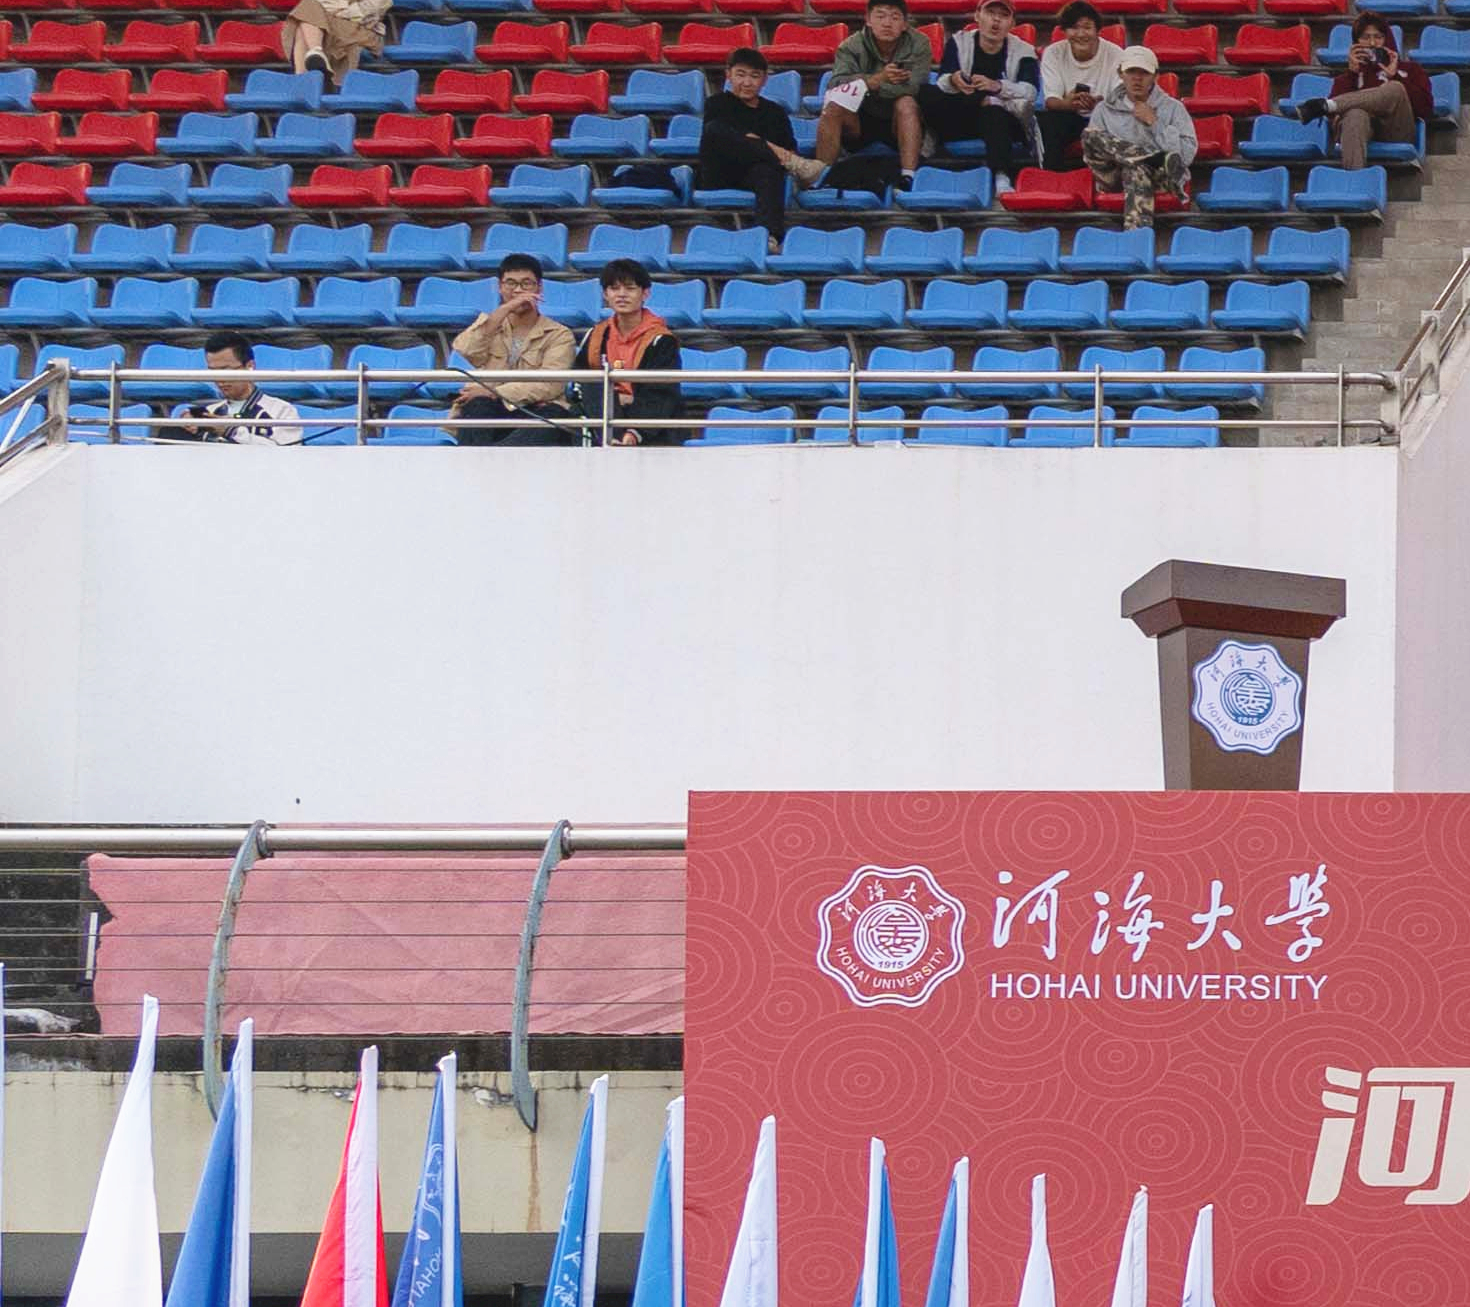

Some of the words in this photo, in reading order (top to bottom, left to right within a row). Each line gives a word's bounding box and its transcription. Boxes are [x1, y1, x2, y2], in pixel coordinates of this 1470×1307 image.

[992, 862, 1331, 964] 河海大学
[872, 947, 946, 990] UNIVERSITY
[991, 973, 1101, 1000] HOHAI
[1114, 973, 1329, 1000] UNIVERSITY
